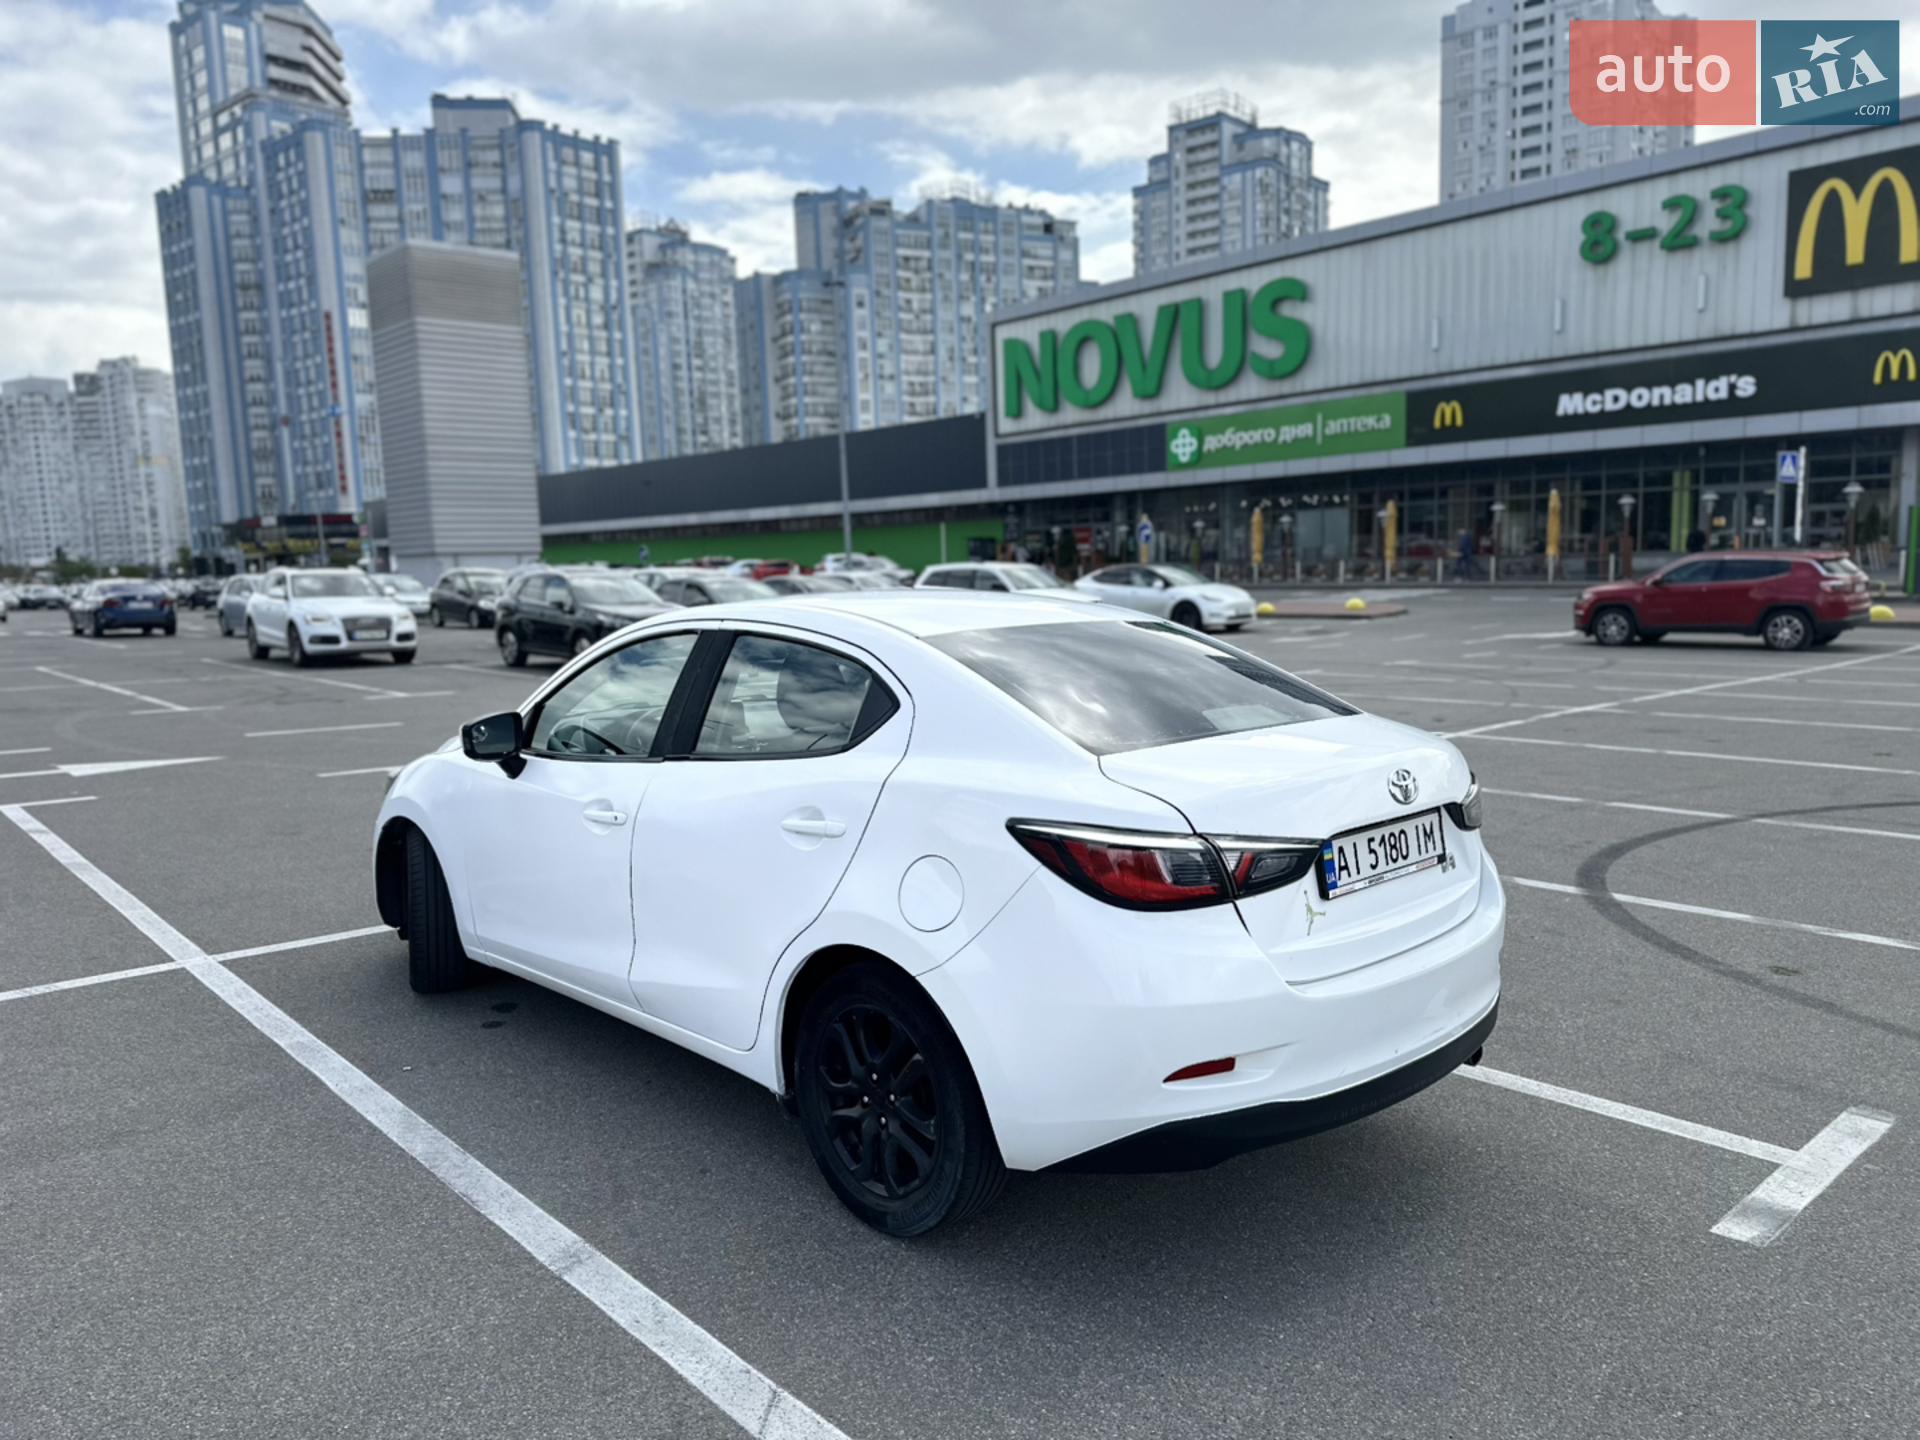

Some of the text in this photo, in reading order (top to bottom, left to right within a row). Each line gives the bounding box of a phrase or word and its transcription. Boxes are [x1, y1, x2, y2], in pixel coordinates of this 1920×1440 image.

[1003, 277, 1312, 419] NOVUS
[1556, 373, 1757, 417] McDonald's
[1202, 412, 1392, 453] доброго дня аптека
[1338, 820, 1436, 880] AI 5180 IM
